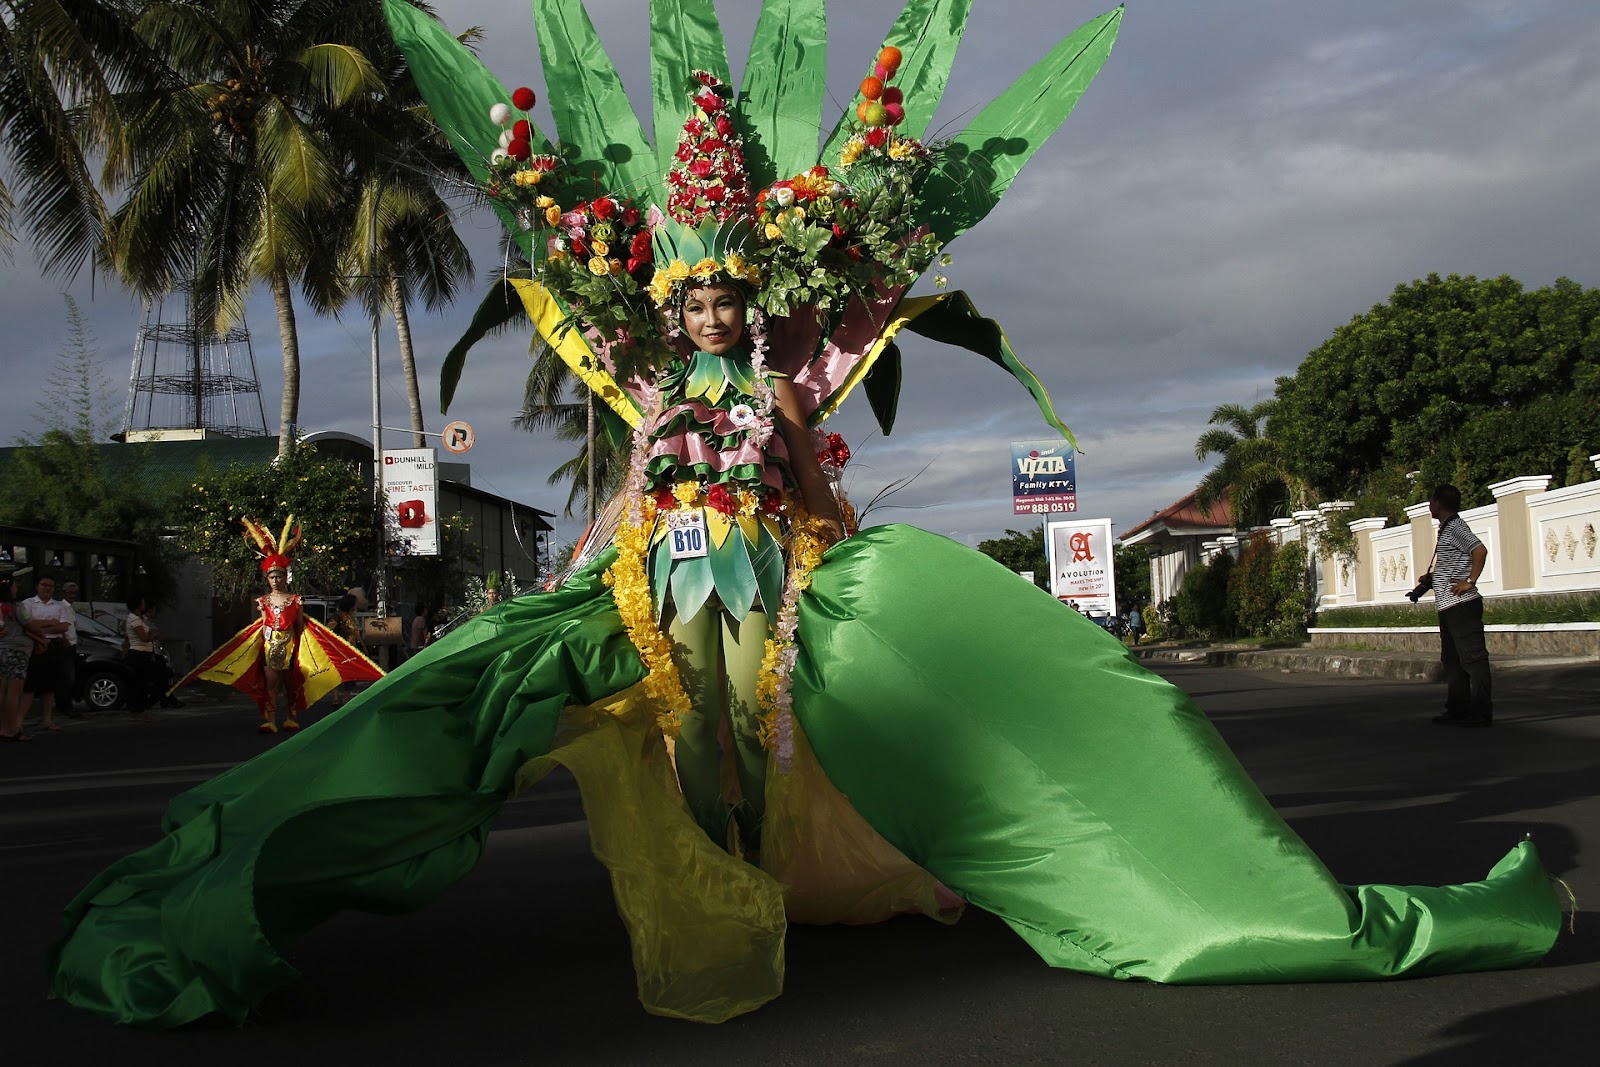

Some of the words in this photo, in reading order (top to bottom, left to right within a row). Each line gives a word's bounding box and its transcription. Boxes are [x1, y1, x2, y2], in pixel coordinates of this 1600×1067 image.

[451, 428, 467, 447] P
[394, 456, 426, 464] DUNHILL
[1017, 456, 1068, 478] VIZTA
[407, 484, 434, 492] TASTE
[1020, 481, 1047, 489] Family
[1048, 480, 1069, 488] KTV
[1031, 503, 1049, 513] 888
[1051, 502, 1075, 512] 0519
[673, 528, 702, 552] B10
[1060, 569, 1104, 579] AVOLUTION
